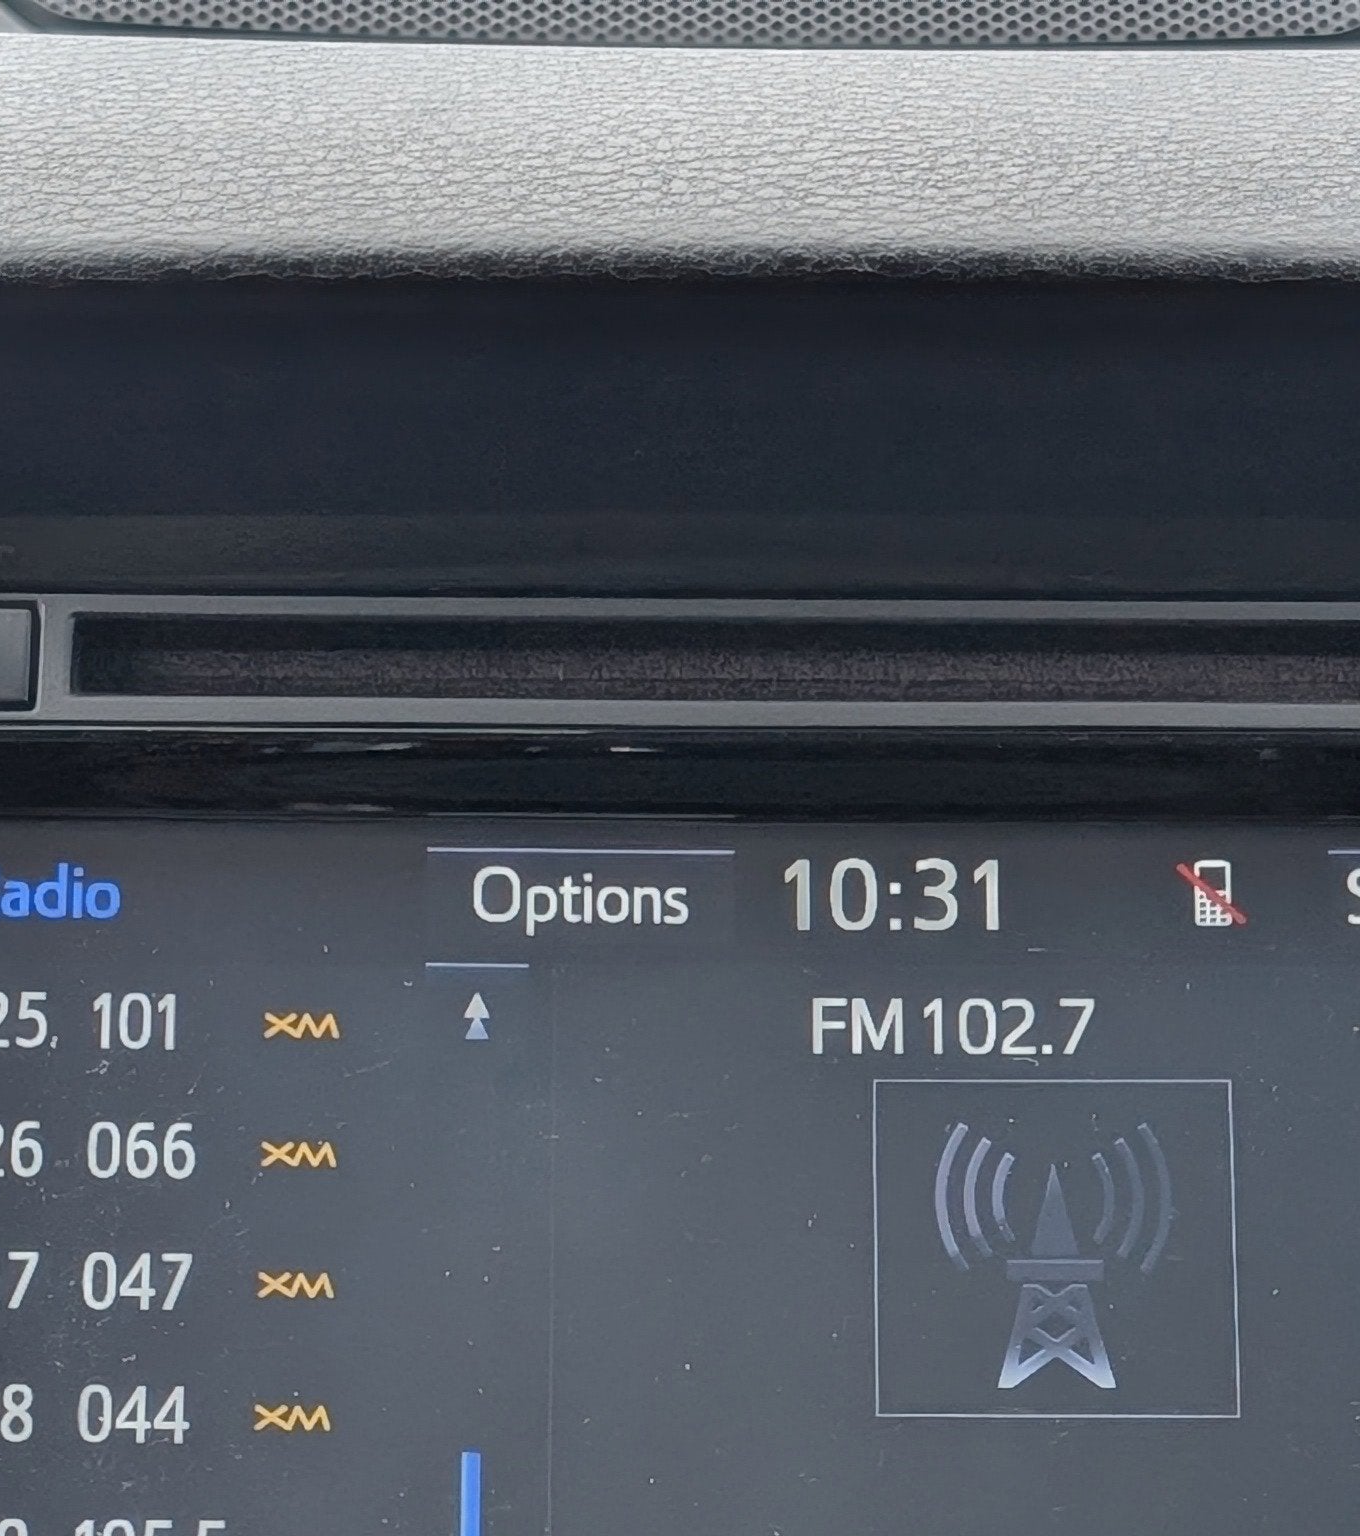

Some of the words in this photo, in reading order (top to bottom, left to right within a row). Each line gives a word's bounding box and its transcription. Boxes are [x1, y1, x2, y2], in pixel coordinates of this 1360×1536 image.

[472, 865, 690, 936] Options
[783, 857, 1002, 933] 10:31
[92, 992, 178, 1051] 101
[263, 1012, 340, 1040] XM
[811, 997, 905, 1055] FM
[921, 996, 1096, 1056] 102.7
[86, 1120, 197, 1181] 066
[260, 1141, 338, 1169] XM
[80, 1251, 193, 1311] 047
[256, 1271, 335, 1300] XM
[76, 1384, 190, 1445] 044
[253, 1403, 332, 1432] XM
